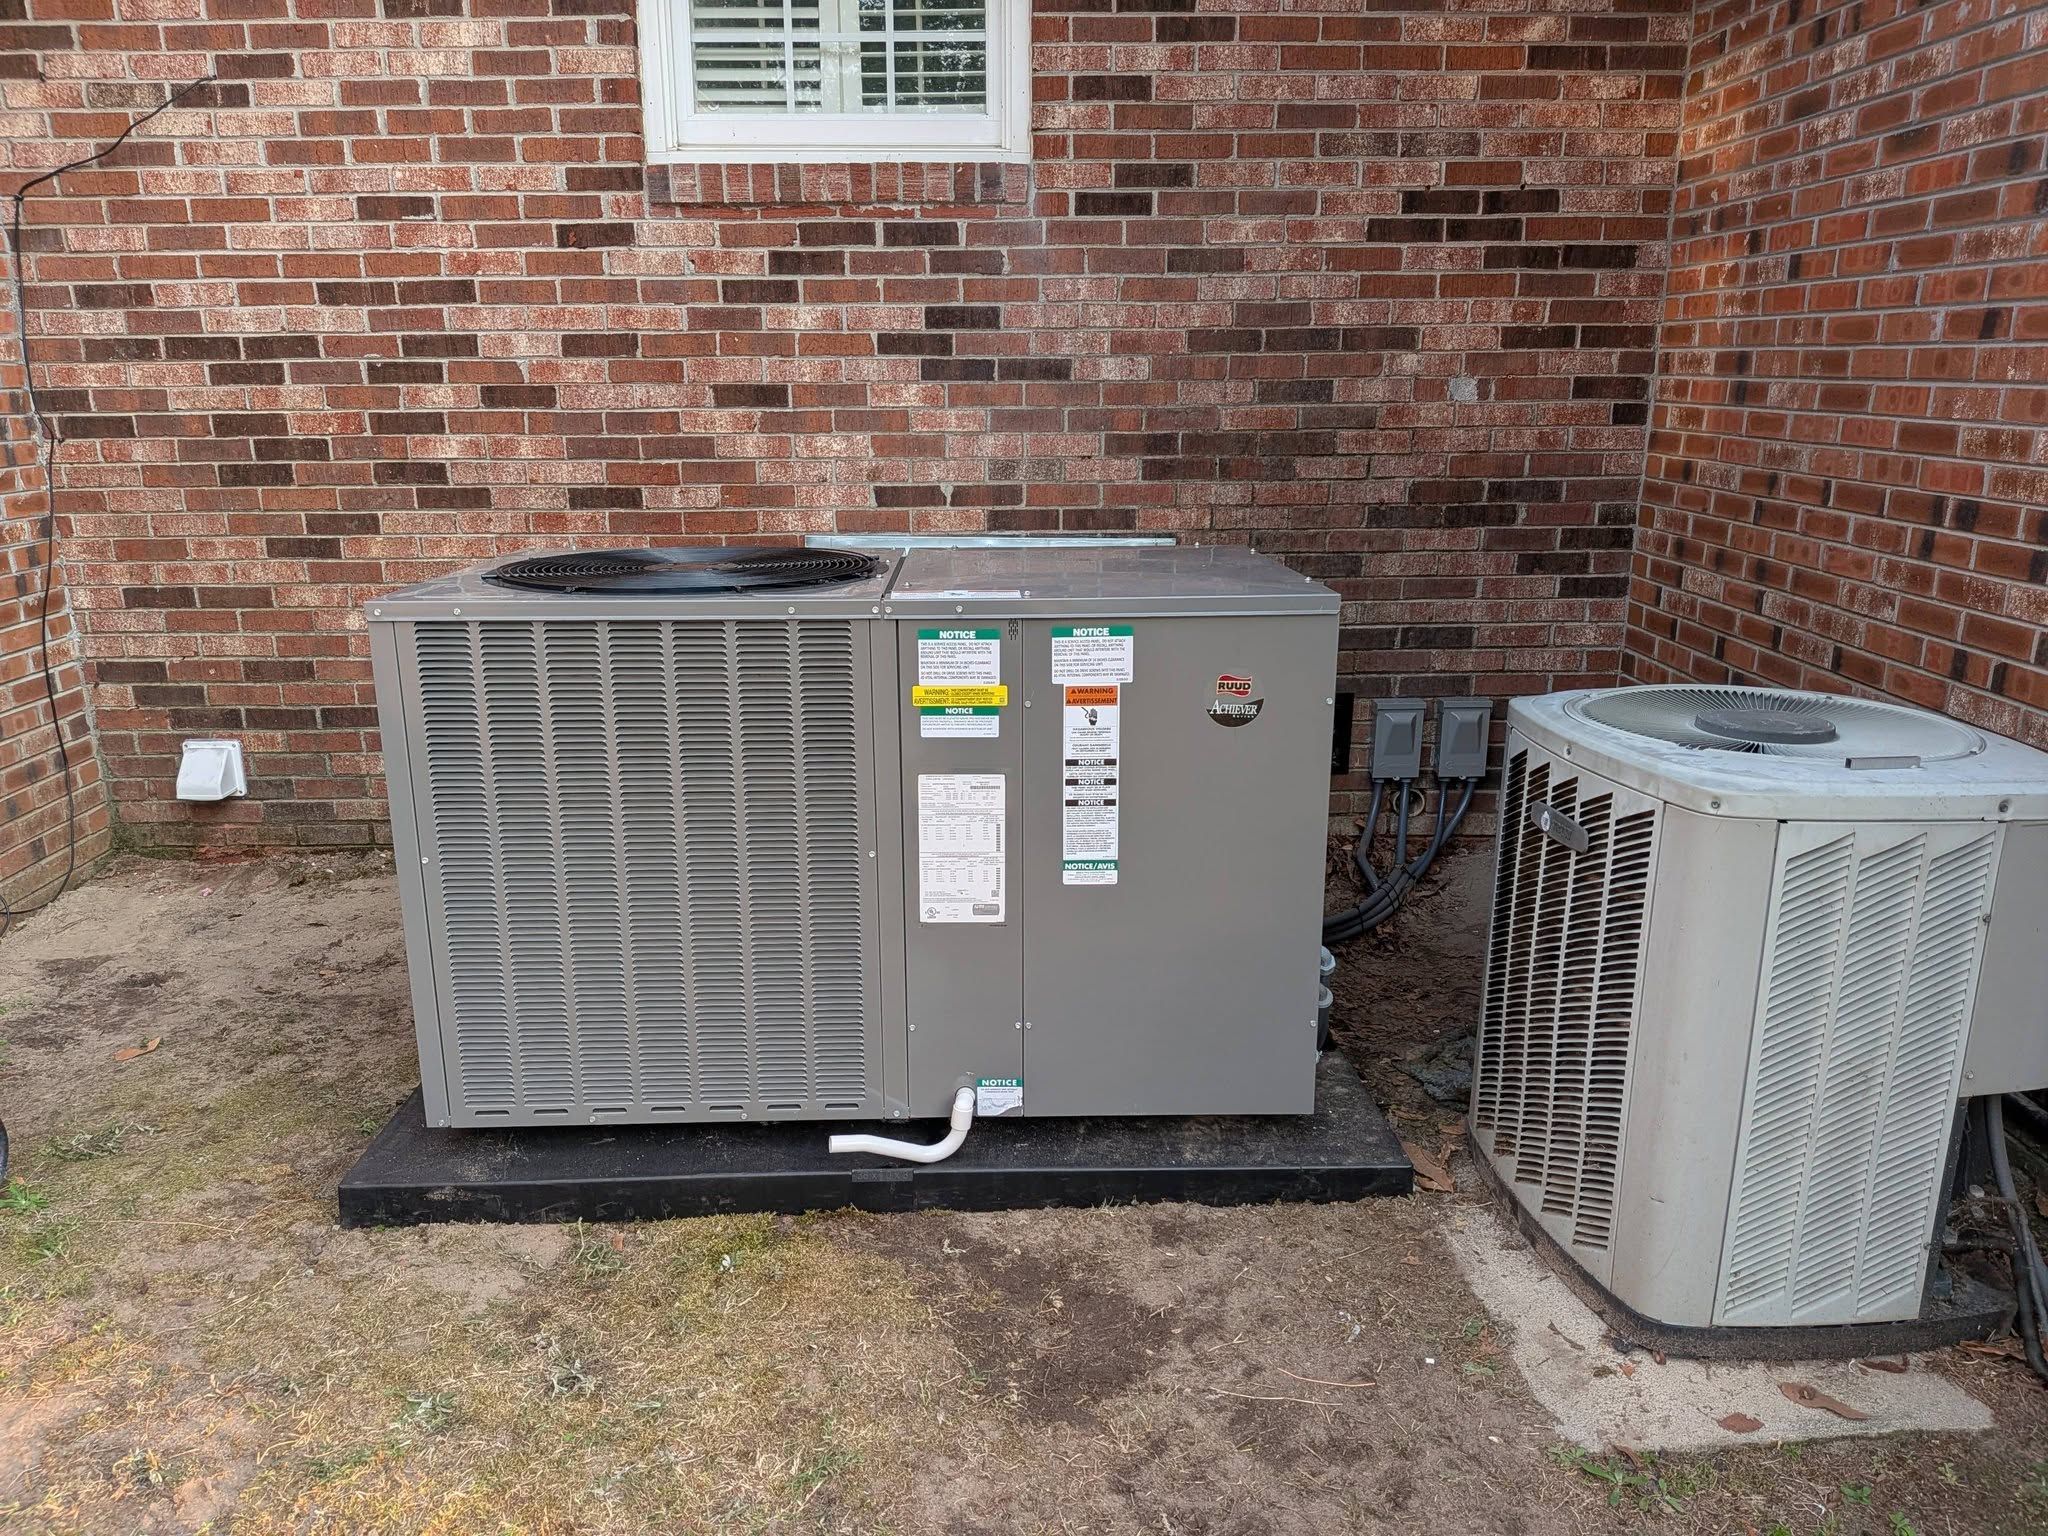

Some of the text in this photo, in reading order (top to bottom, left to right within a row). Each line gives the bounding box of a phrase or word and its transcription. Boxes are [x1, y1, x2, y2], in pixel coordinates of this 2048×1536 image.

[939, 631, 976, 639] NOTICE
[1073, 628, 1110, 636] NOTICE
[1218, 682, 1251, 690] RUUD
[924, 688, 950, 696] WARNING:
[1210, 699, 1257, 714] ACHIEVER
